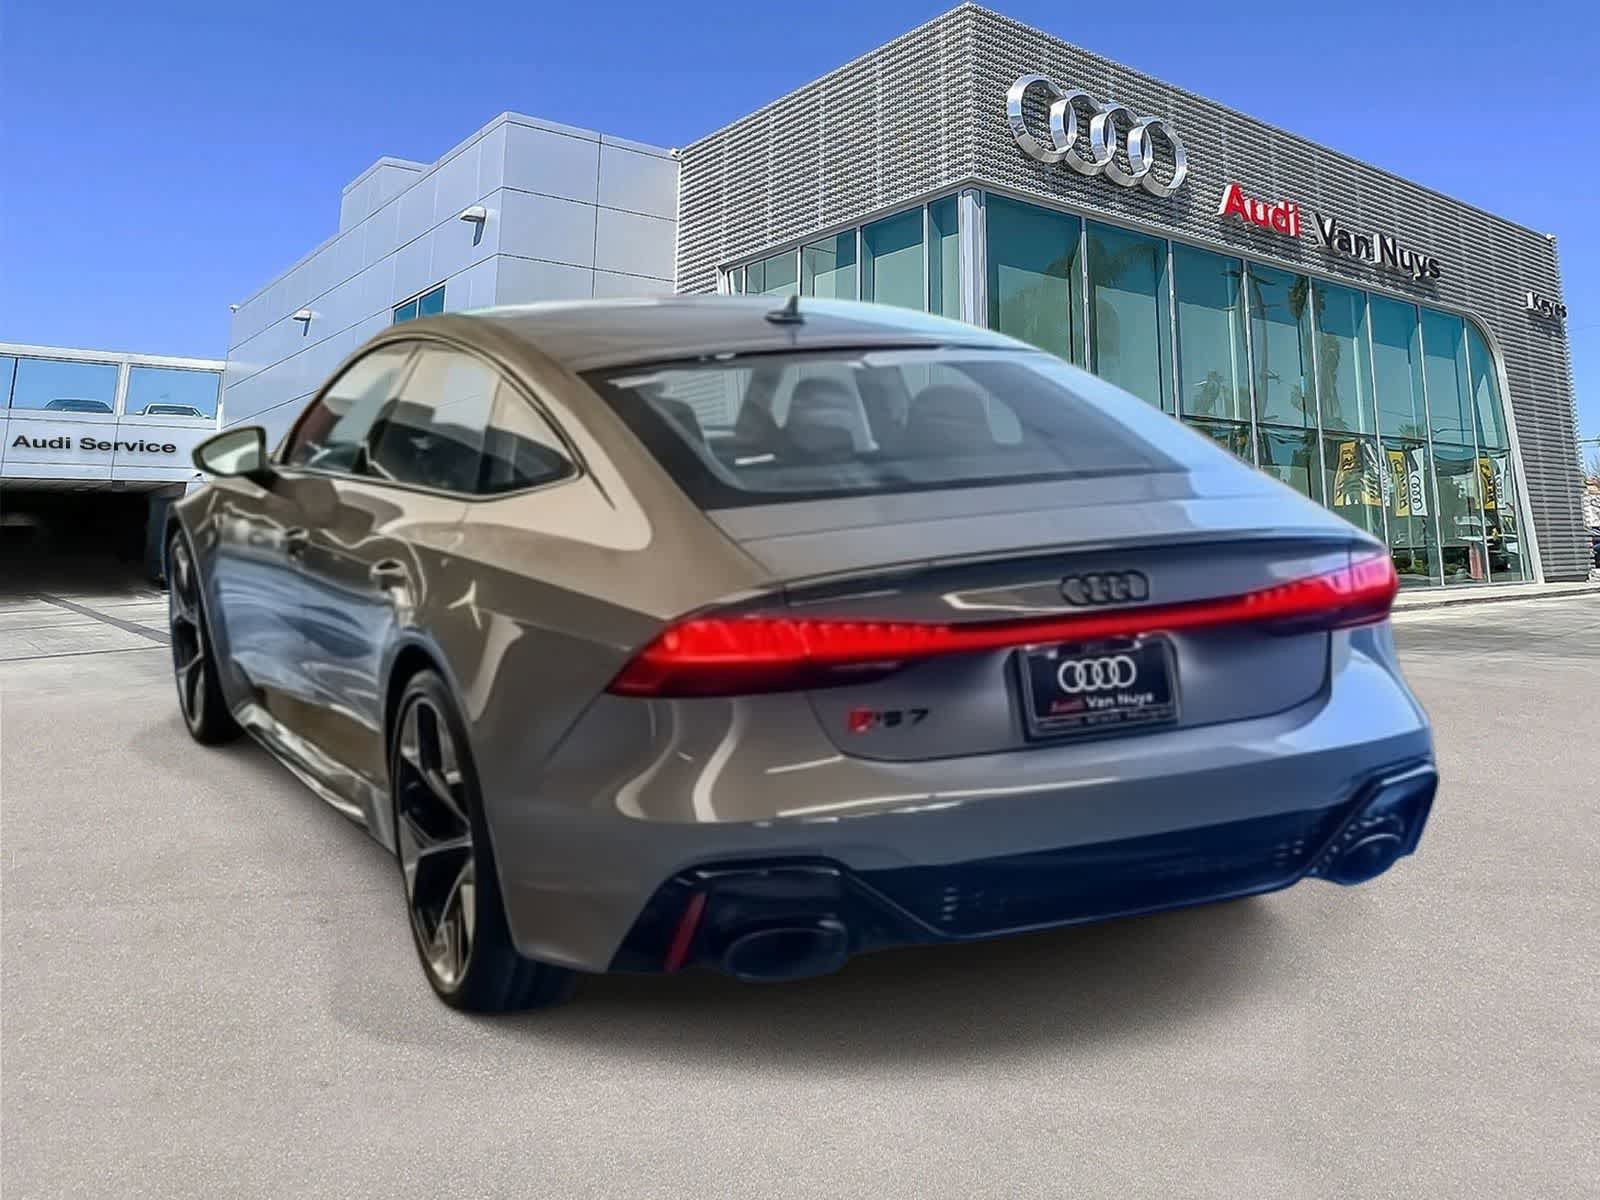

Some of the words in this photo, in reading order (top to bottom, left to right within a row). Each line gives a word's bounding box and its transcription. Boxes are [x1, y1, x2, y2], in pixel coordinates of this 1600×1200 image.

[1218, 183, 1301, 237] Audi
[1312, 212, 1370, 259] Van
[1374, 232, 1441, 280] Nuys
[12, 435, 71, 449] Audi
[79, 437, 177, 454] Service
[1086, 695, 1115, 708] Van
